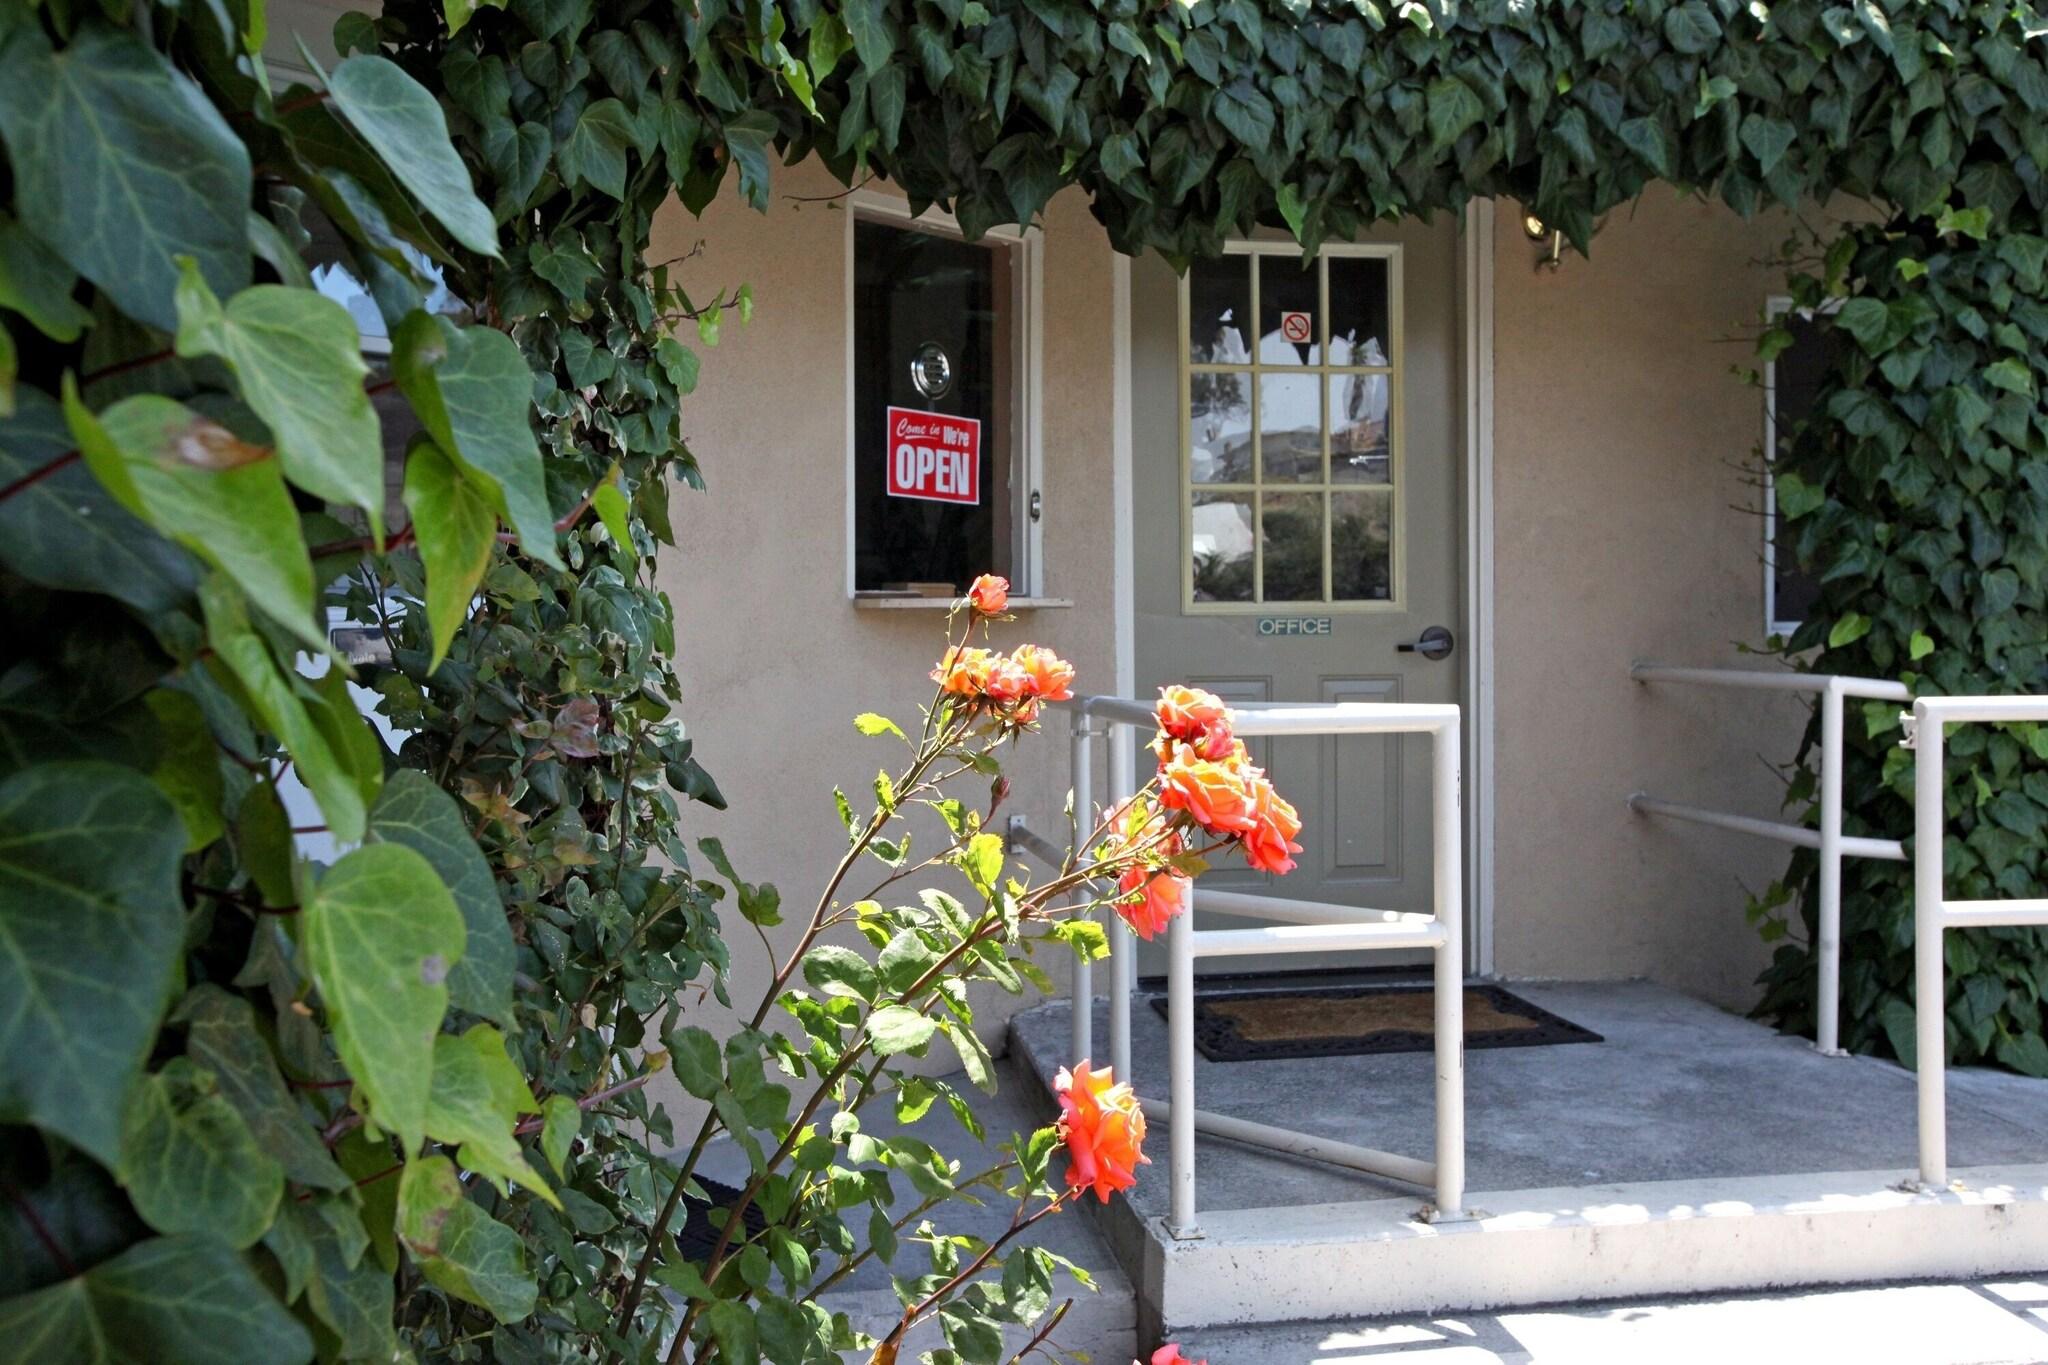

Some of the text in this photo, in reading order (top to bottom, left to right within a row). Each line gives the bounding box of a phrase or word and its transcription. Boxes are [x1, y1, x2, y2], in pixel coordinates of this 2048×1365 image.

[896, 418, 970, 447] Come in We're
[895, 443, 970, 495] OPEN
[1260, 619, 1330, 634] OFFICE
